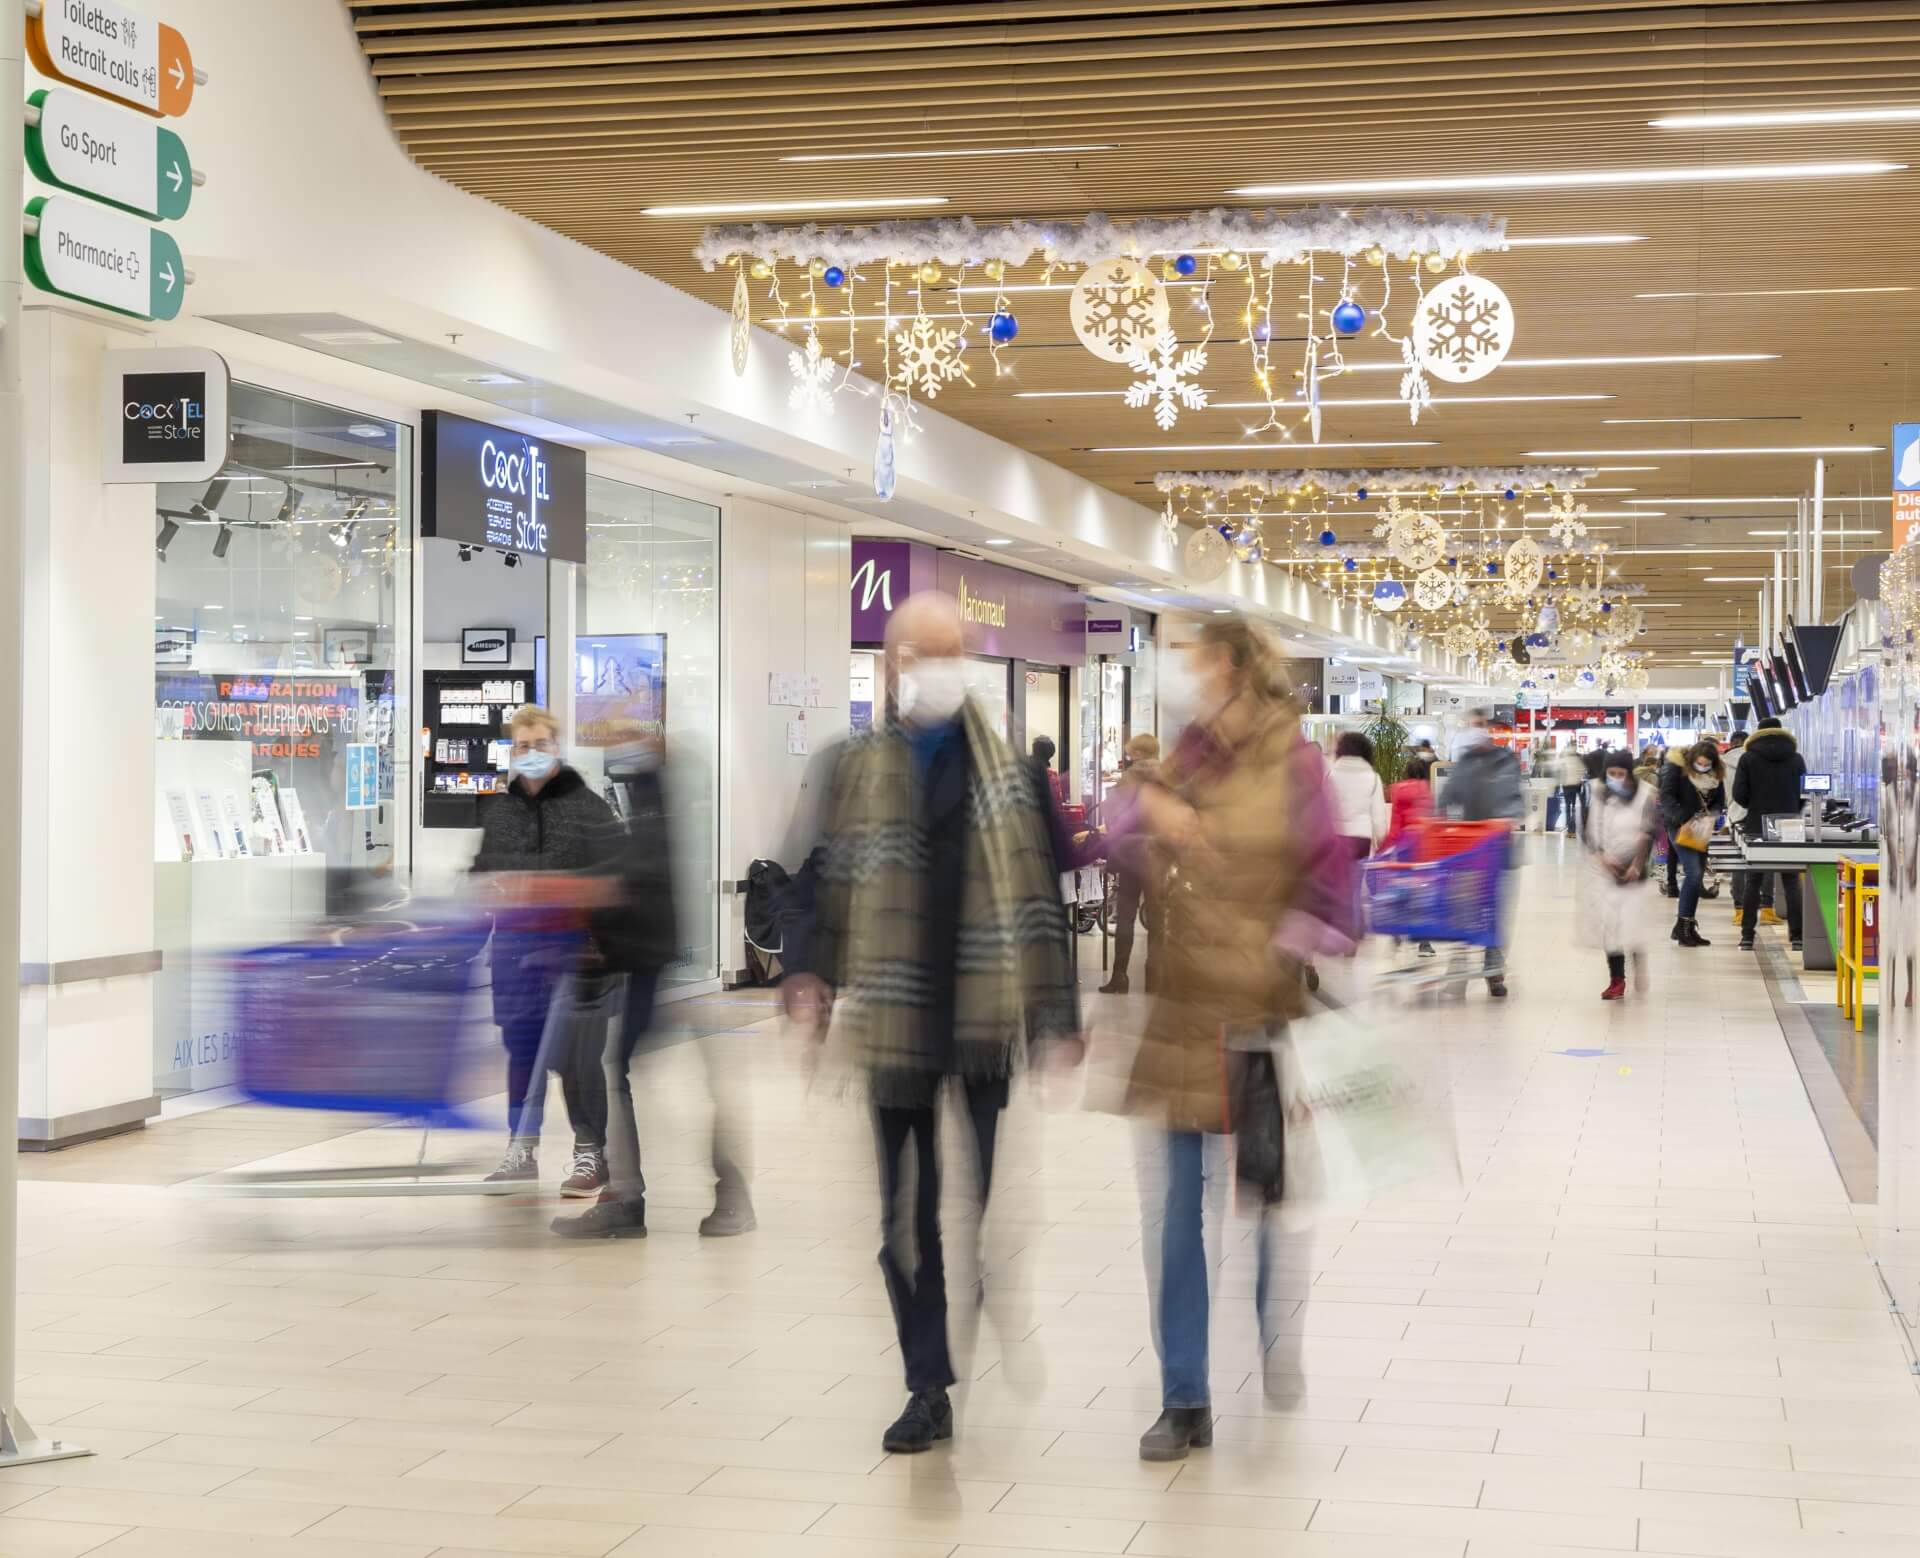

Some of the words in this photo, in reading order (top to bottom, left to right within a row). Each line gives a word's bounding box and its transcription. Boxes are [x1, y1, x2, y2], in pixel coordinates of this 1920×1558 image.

[63, 0, 118, 39] Toilettes
[61, 35, 107, 76] Retrait
[110, 60, 139, 87] colis
[60, 124, 79, 151] Go
[82, 131, 117, 166] Sport
[58, 231, 123, 274] Pharmacie
[164, 424, 201, 440] Store
[516, 511, 548, 553] Store
[957, 575, 1006, 628] Marionnaud
[156, 700, 242, 731] ESSOIRES
[255, 703, 329, 734] TELEPHONES
[1586, 714, 1621, 726] exert
[251, 742, 321, 759] ARQUES
[173, 1039, 195, 1070] AIX
[197, 1034, 219, 1066] LES
